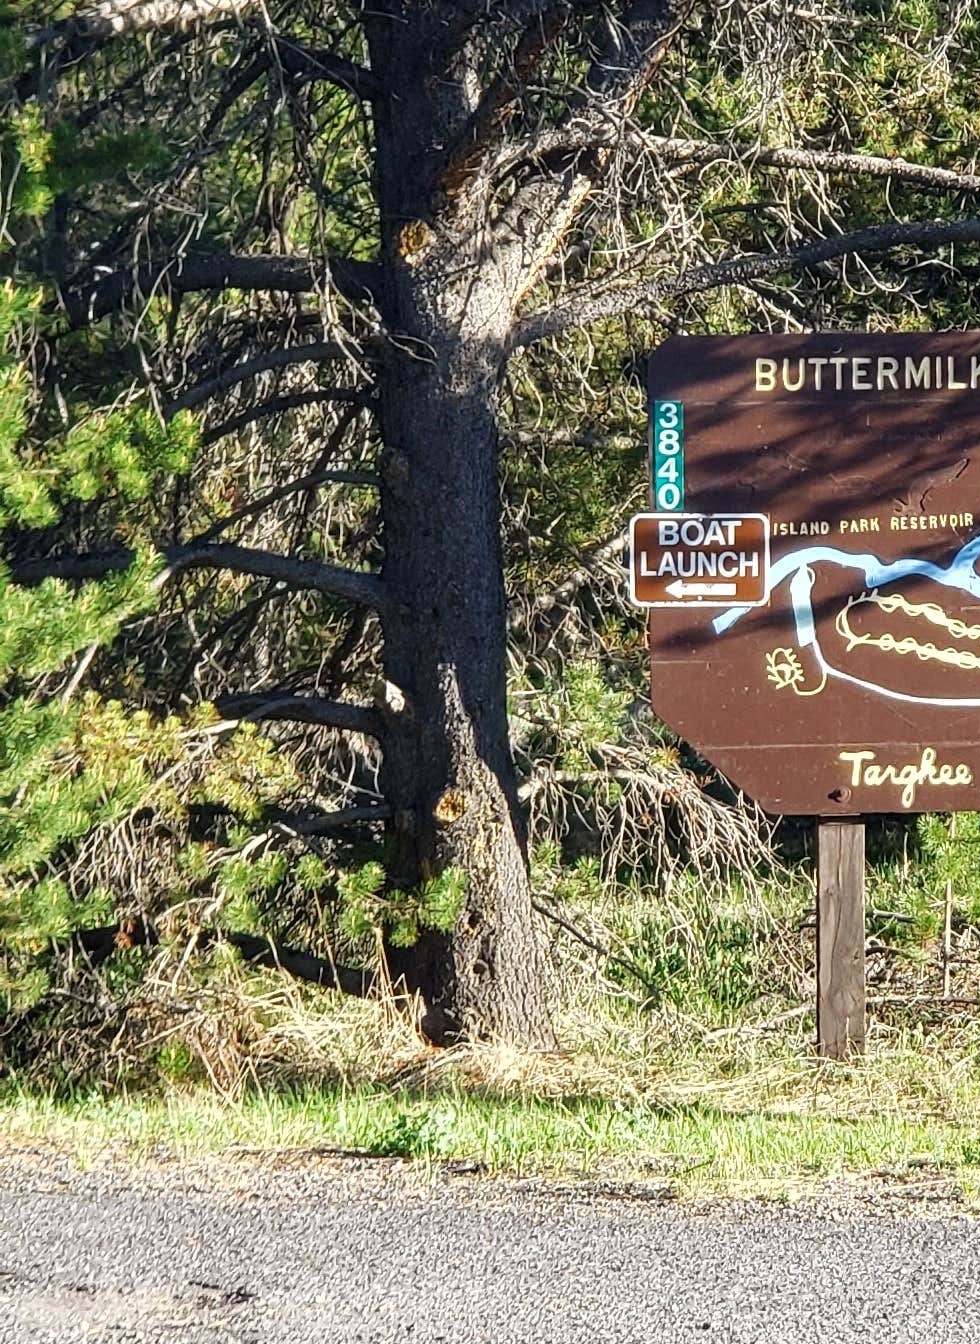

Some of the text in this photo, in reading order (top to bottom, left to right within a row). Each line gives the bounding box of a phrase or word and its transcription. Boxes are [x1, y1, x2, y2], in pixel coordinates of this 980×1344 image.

[657, 402, 681, 511] 3840
[658, 520, 742, 546] BOAT
[773, 512, 974, 536] ISLAND PARK RESERVOIR
[640, 551, 759, 577] LAUNCH
[839, 747, 972, 808] Targhee
